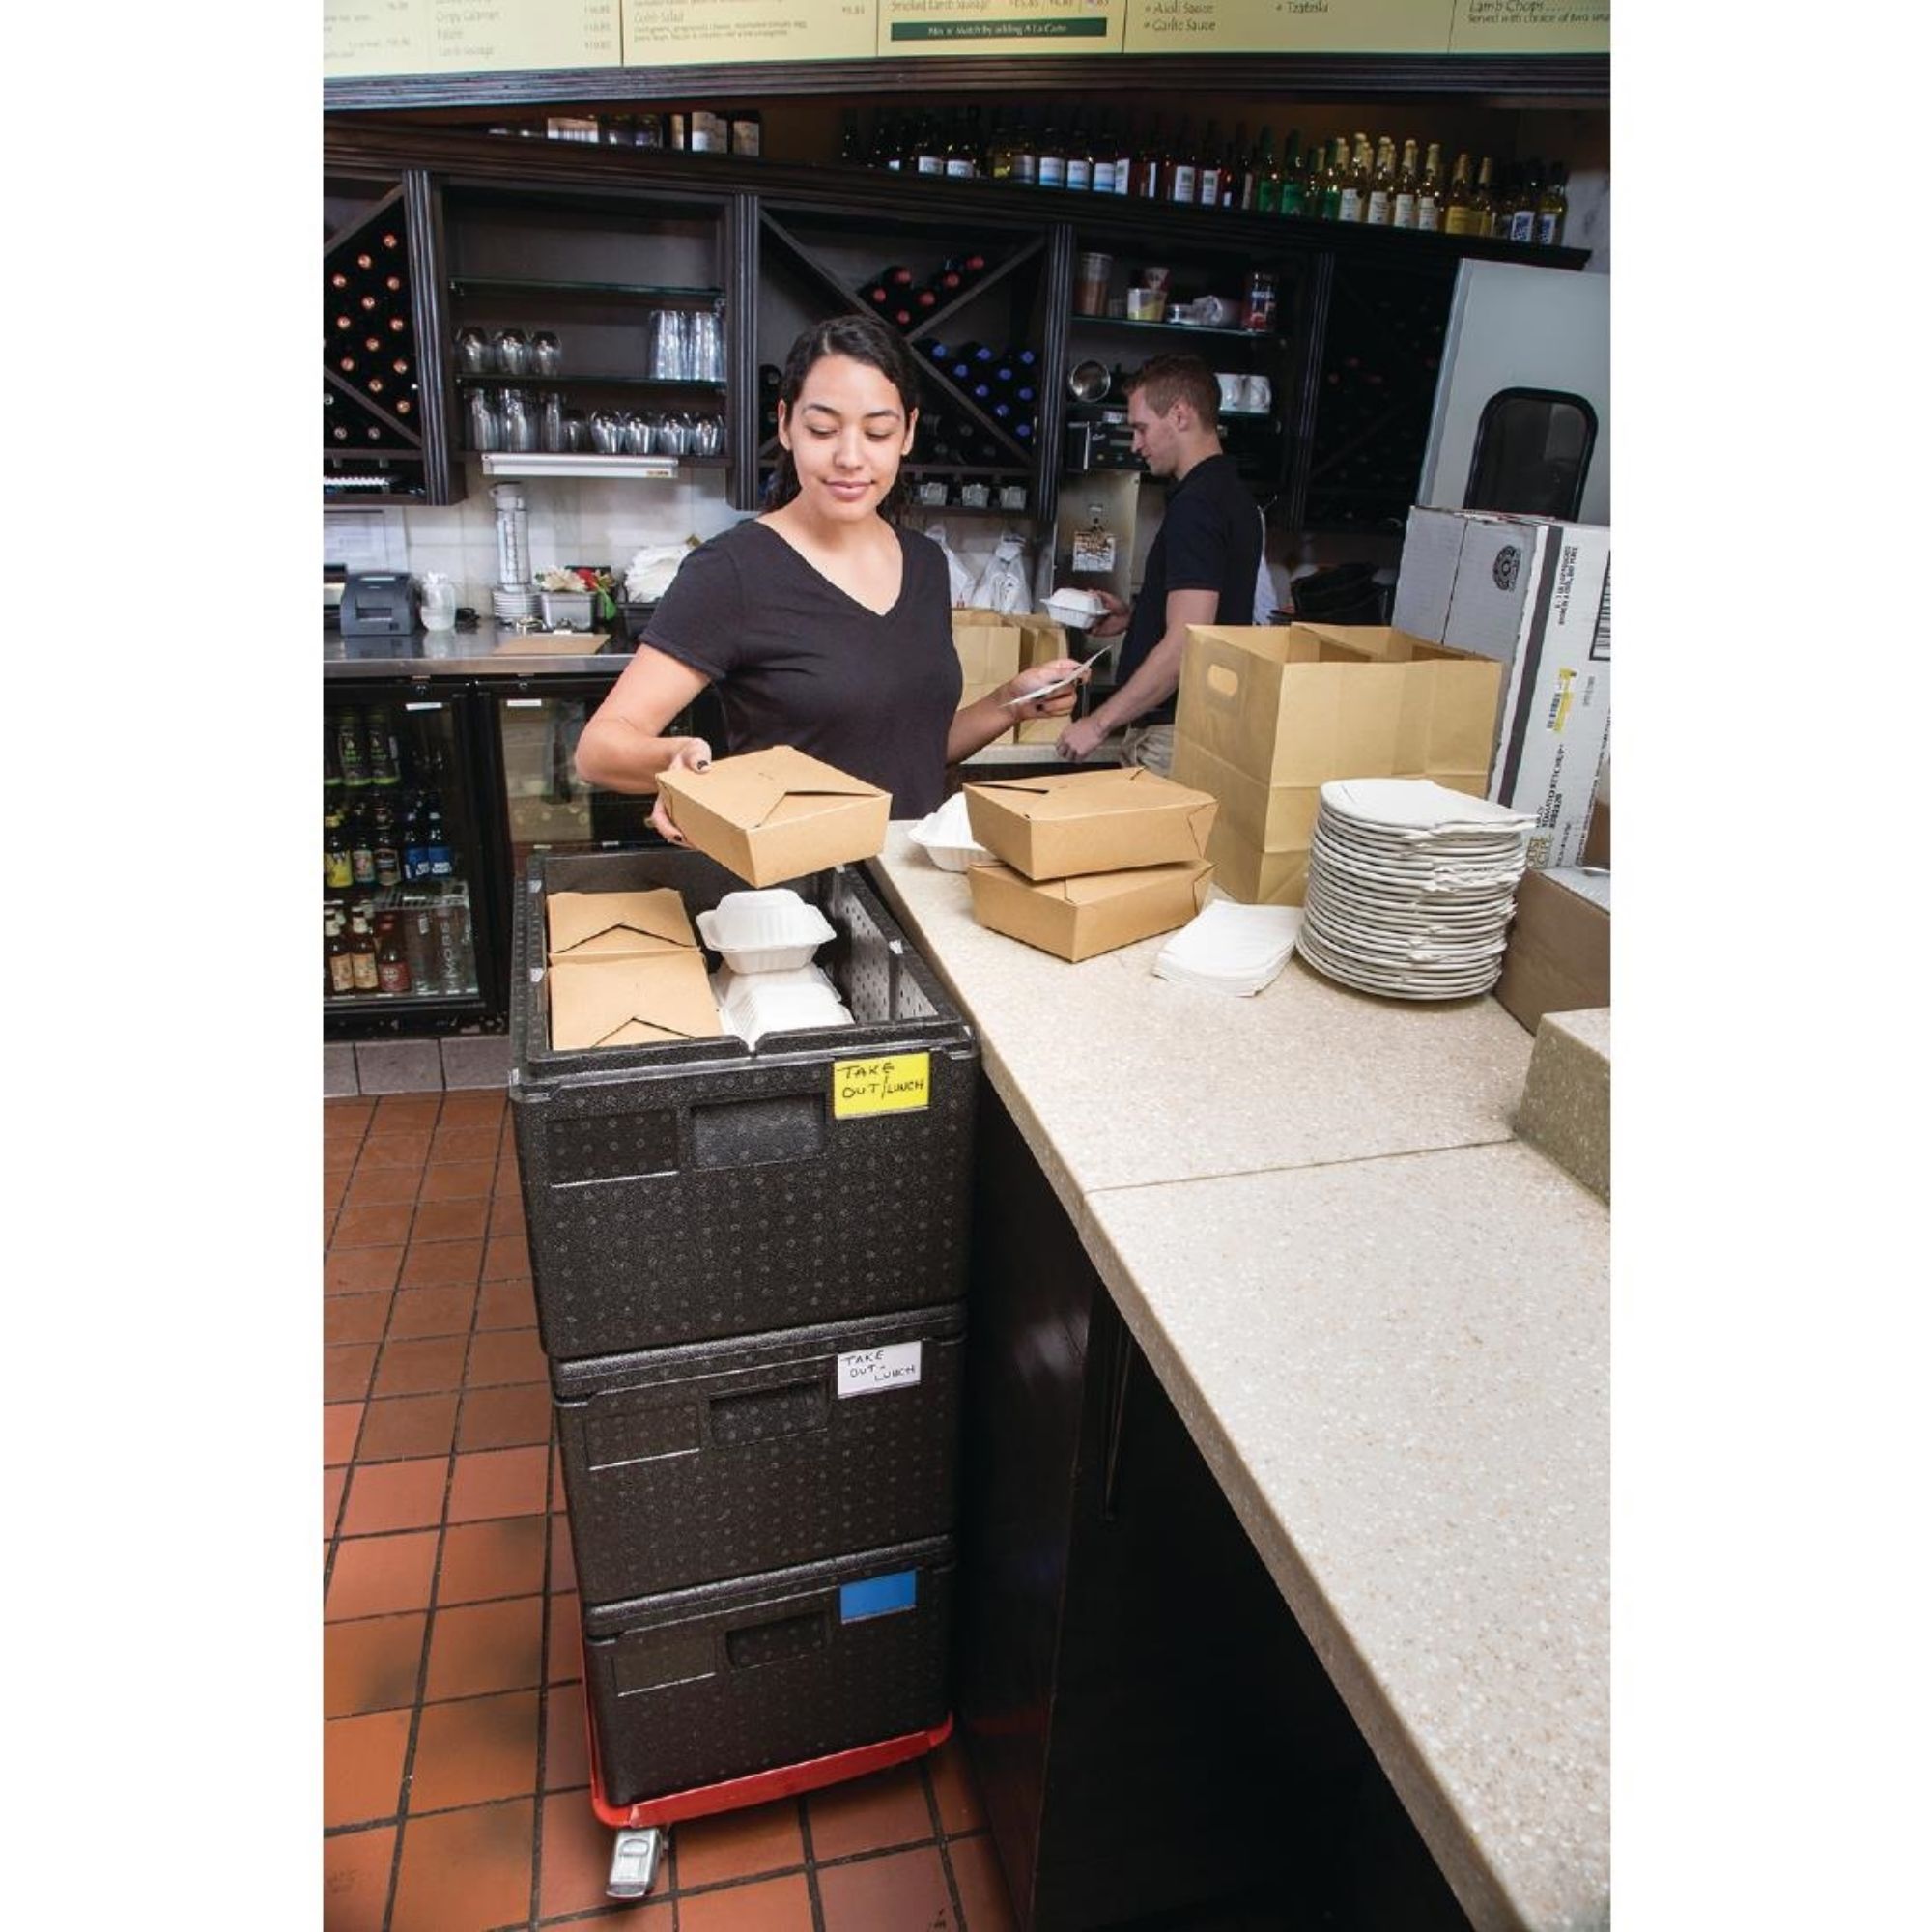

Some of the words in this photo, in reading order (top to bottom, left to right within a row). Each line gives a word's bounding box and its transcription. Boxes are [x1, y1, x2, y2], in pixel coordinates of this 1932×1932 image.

[1151, 17, 1184, 32] Garlic
[1186, 17, 1217, 32] Sauce
[837, 1063, 895, 1079] TAKE
[840, 1350, 884, 1365] TAKE
[874, 1364, 915, 1381] LUNCH
